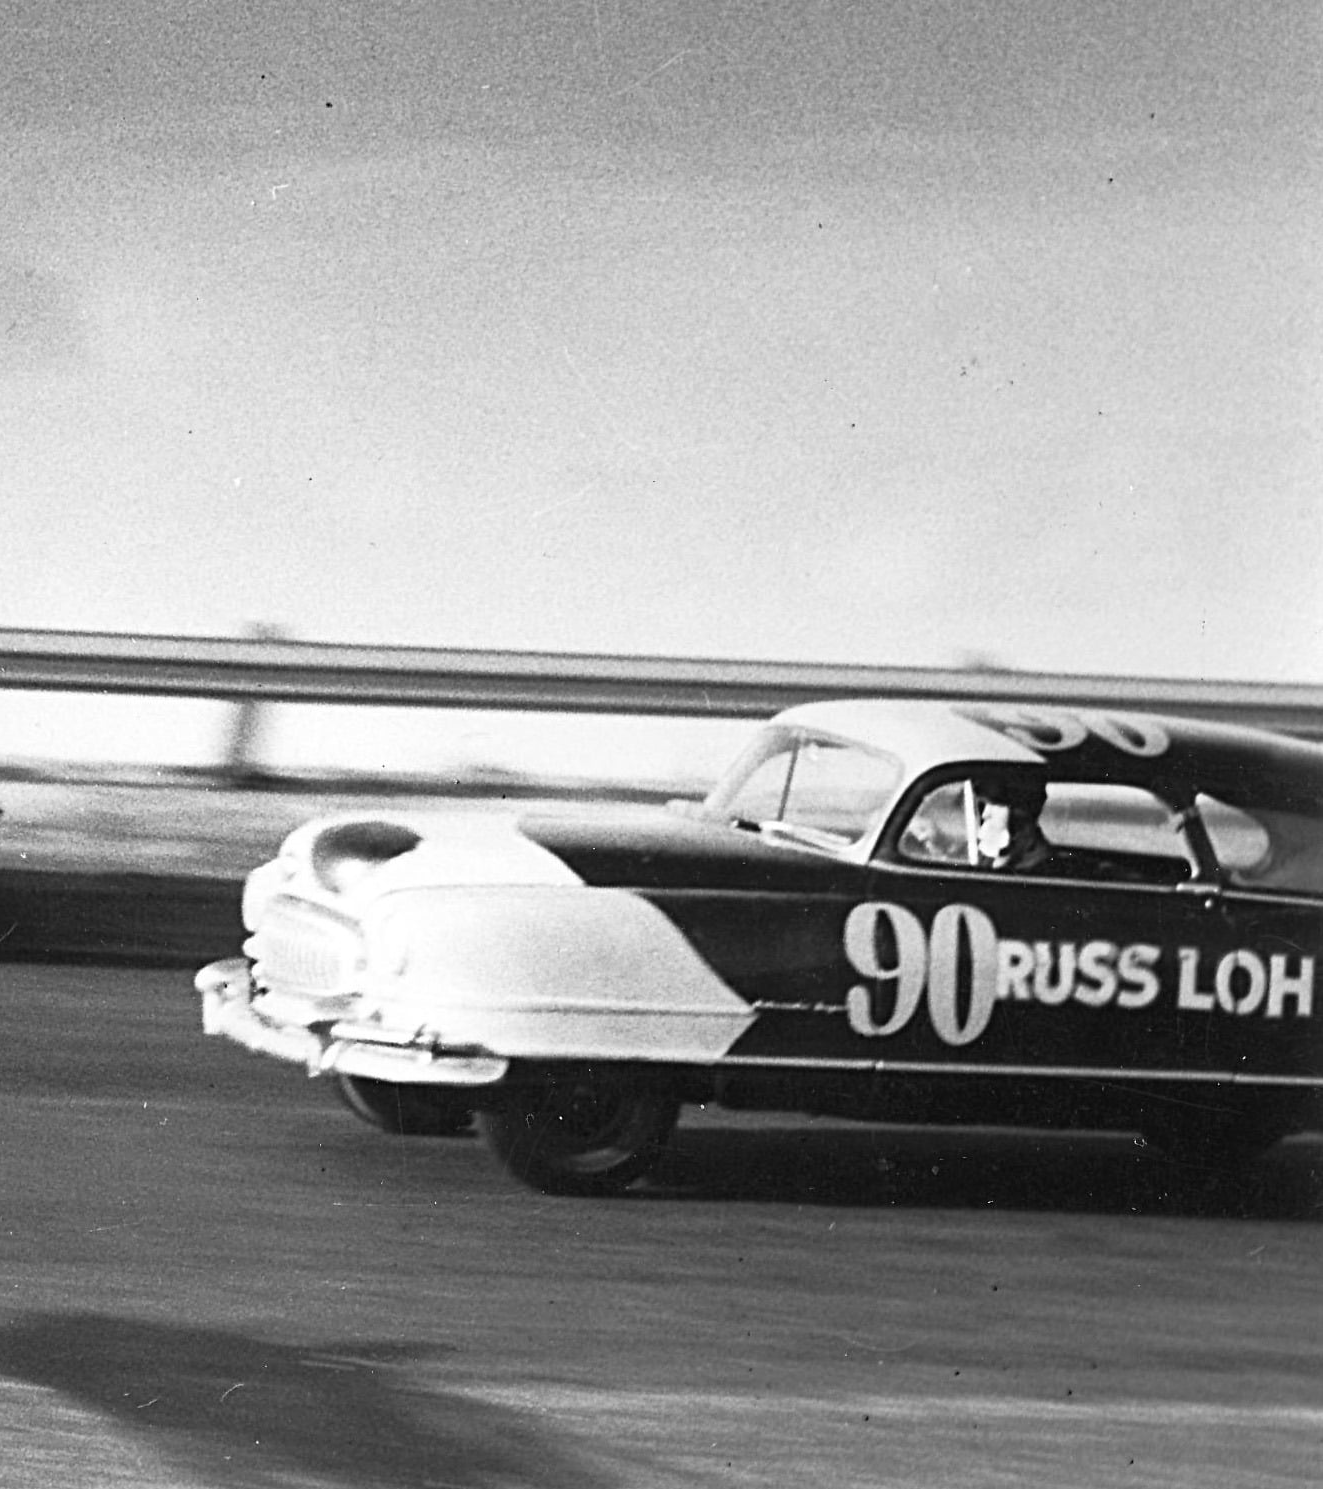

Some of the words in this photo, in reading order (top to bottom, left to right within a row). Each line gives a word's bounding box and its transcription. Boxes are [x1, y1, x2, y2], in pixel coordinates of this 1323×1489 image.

[843, 901, 998, 1046] 90
[996, 940, 1161, 1008] RUSS
[1177, 944, 1316, 1019] LOH
